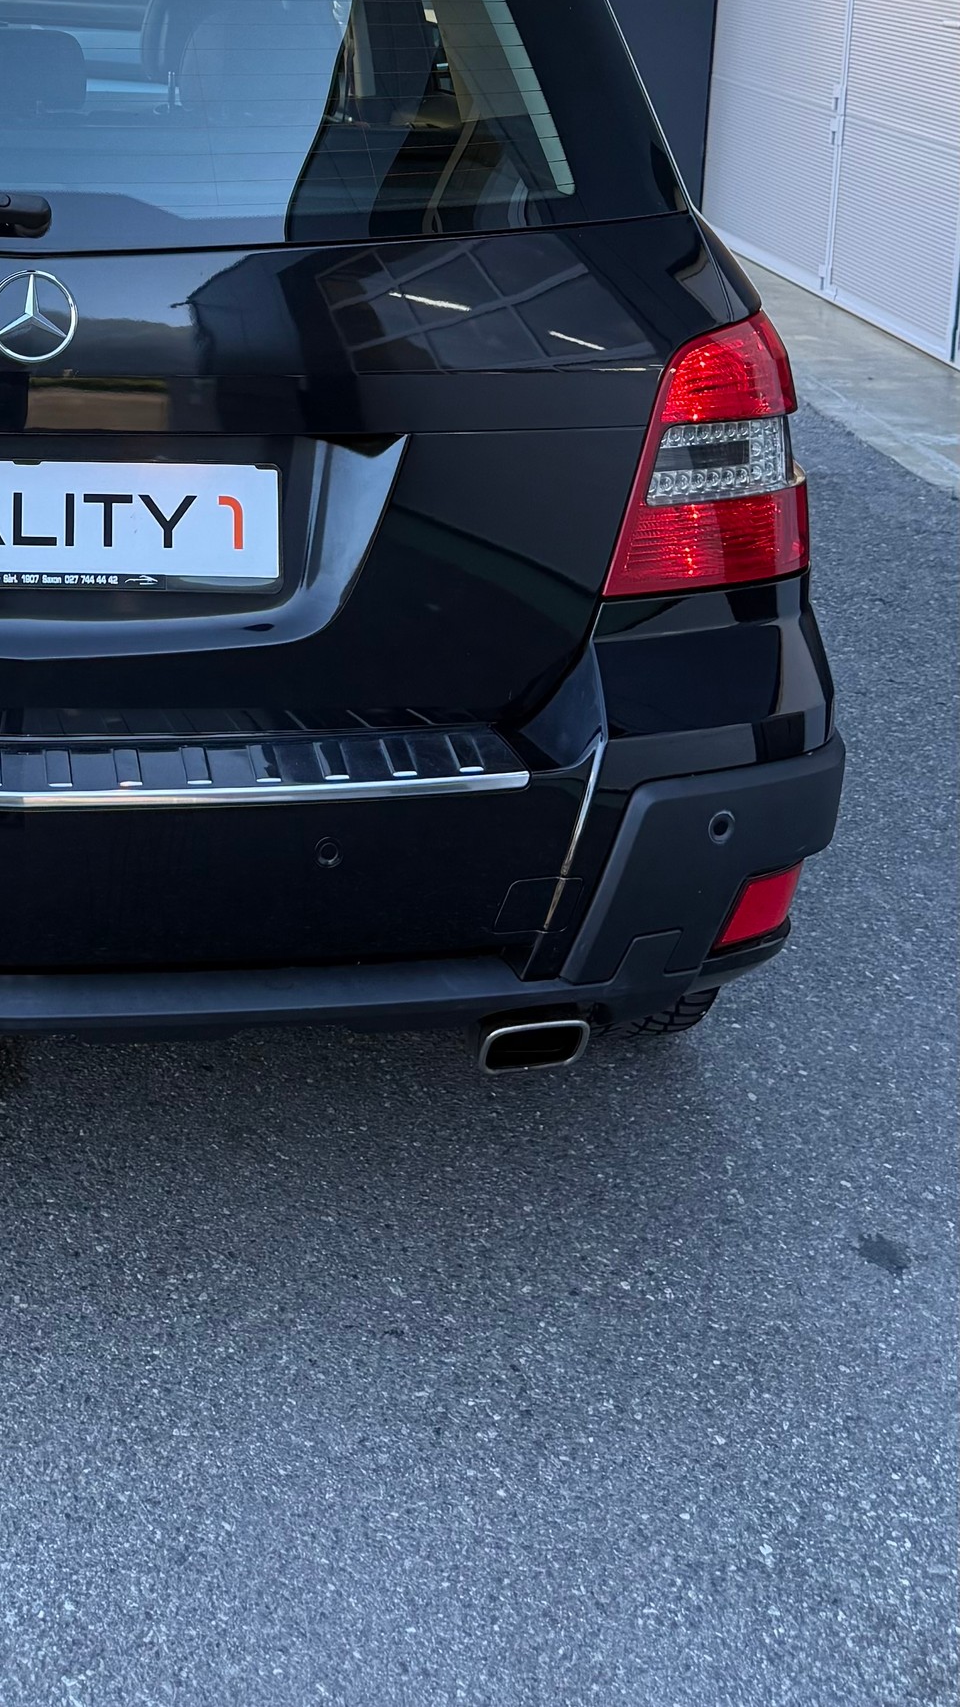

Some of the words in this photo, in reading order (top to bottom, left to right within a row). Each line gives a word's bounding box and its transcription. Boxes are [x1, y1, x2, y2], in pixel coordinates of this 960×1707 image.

[21, 574, 39, 584] 1907
[42, 575, 62, 584] Saxon
[64, 575, 79, 584] 027
[80, 575, 94, 584] 744
[96, 575, 106, 584] 44
[107, 575, 119, 585] 42
